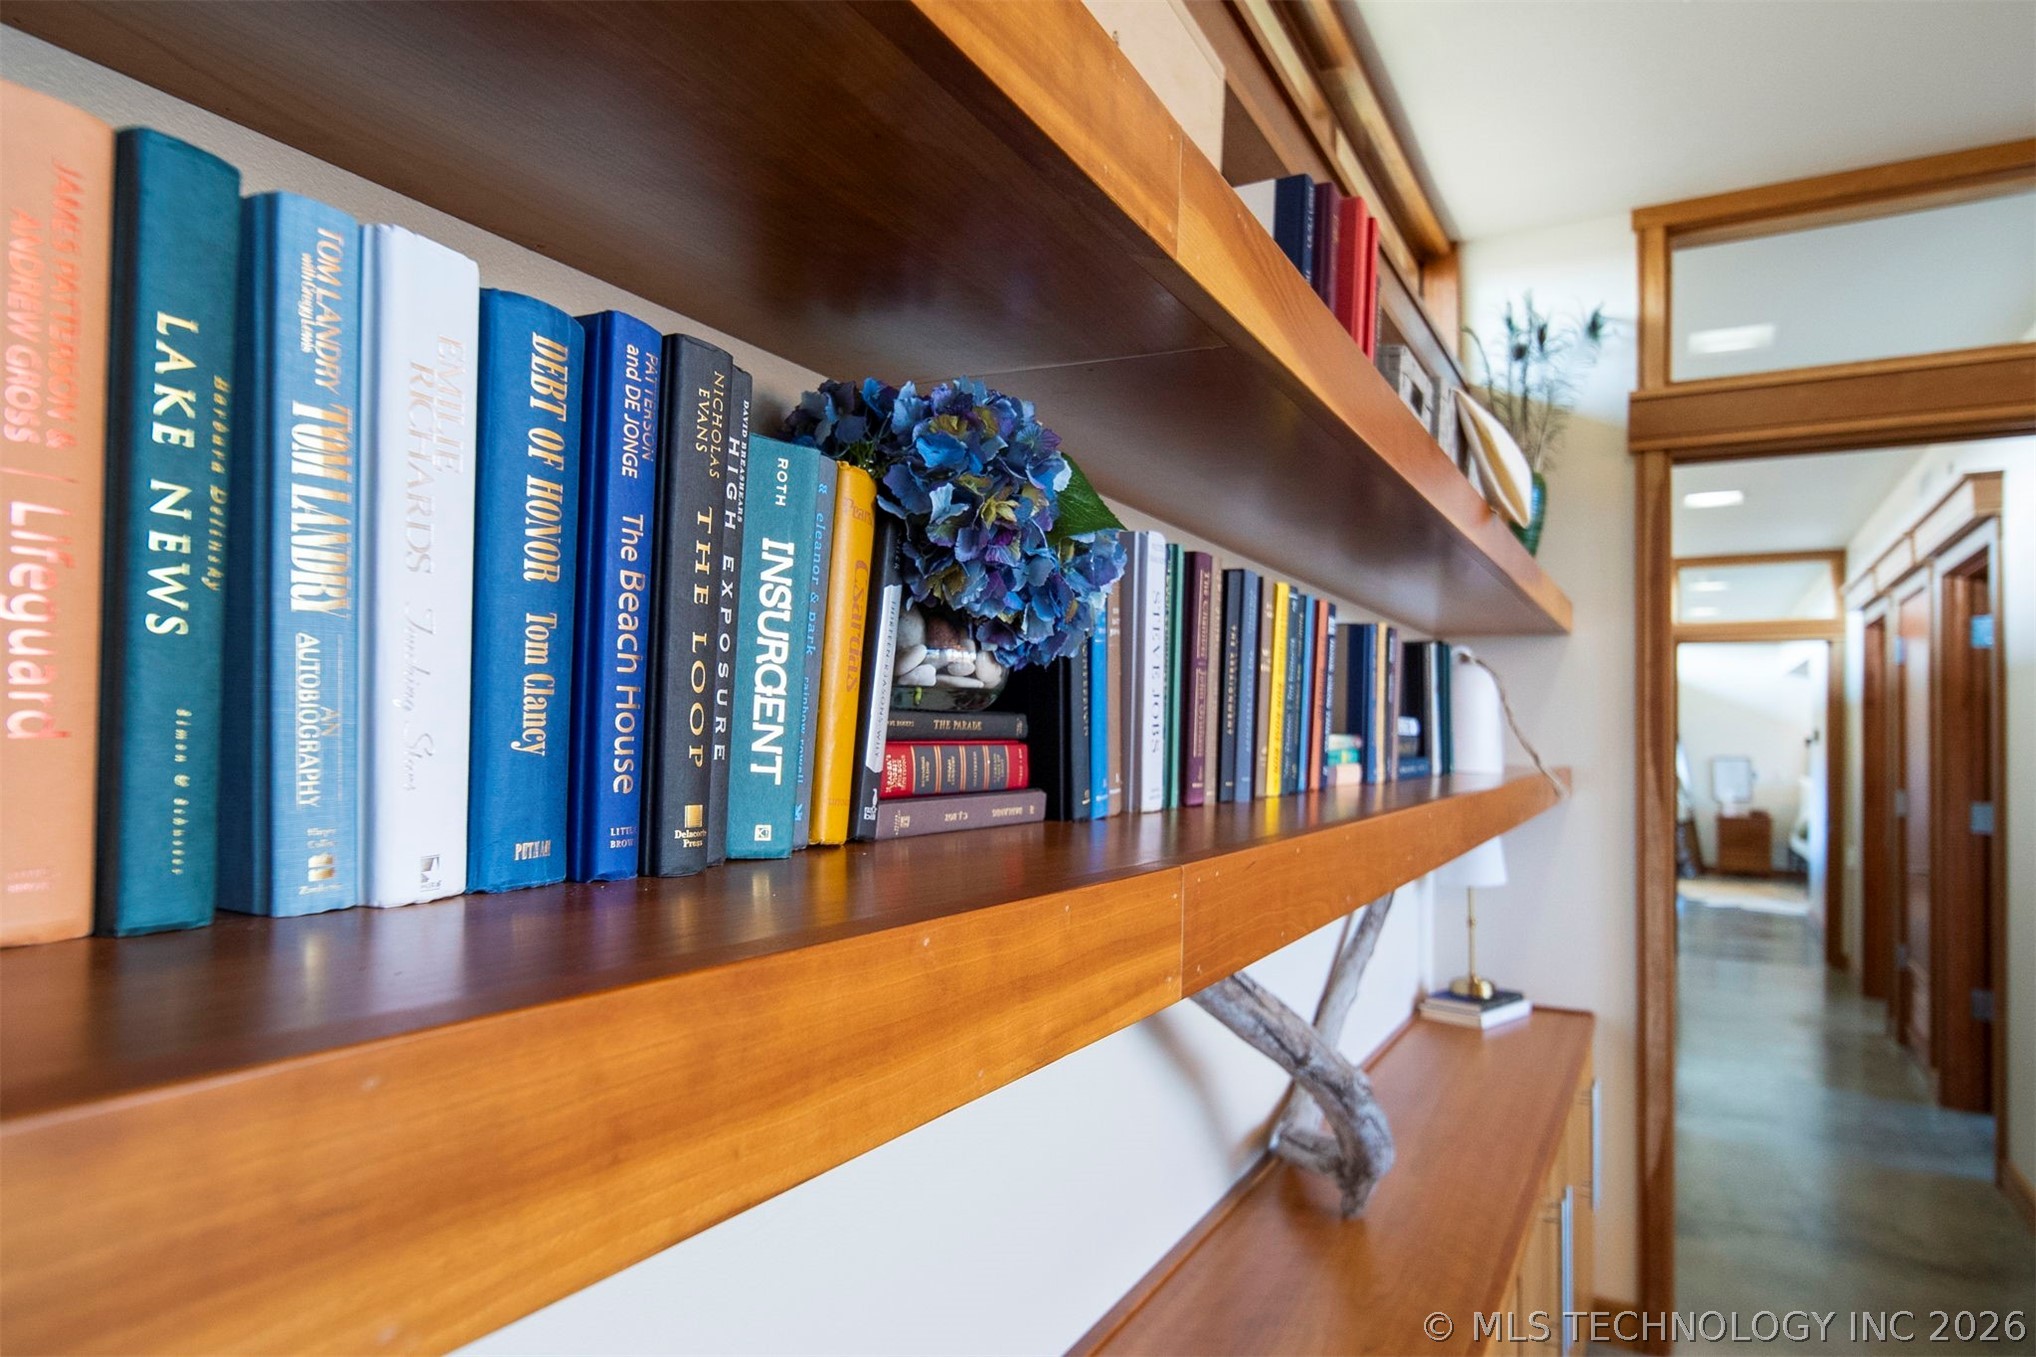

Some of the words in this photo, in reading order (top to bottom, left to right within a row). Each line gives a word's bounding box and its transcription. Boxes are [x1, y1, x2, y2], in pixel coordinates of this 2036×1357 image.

[51, 161, 84, 256] JAMES
[316, 227, 345, 287] TOM
[6, 207, 44, 343] ANDREW
[47, 258, 83, 424] PATTERSON
[151, 310, 199, 449] LAKE
[314, 287, 343, 396] LANDRY
[529, 330, 569, 423] DEBT
[625, 343, 642, 383] and
[3, 344, 43, 444] GROSS
[208, 374, 232, 474] Barbara
[291, 399, 353, 484] TOM
[433, 334, 467, 474] EMILIE
[624, 384, 642, 412] DE
[641, 351, 659, 463] PATTERSON
[695, 387, 710, 453] EVANS
[709, 370, 726, 479] NICHOLAS
[741, 399, 750, 438] DAVID
[404, 361, 438, 575] RICHARDS
[527, 427, 566, 472] OF
[621, 412, 641, 479] JONGE
[724, 436, 741, 530] HIGH
[737, 441, 748, 523] BREASHEARS
[774, 457, 789, 507] ROTH
[144, 478, 193, 635] NEWS
[201, 484, 229, 592] Delinsky
[290, 482, 352, 619] LANDRY
[522, 474, 564, 584] HONOR
[620, 514, 644, 562] The
[693, 506, 713, 605] THE
[811, 512, 828, 586] eleanor
[0, 501, 77, 739] Lifeguard
[524, 612, 558, 666] Tom
[616, 569, 646, 674] Beach
[805, 611, 818, 656] park
[808, 591, 820, 604] &
[846, 559, 870, 693] Csardas
[1151, 590, 1161, 680] STEVE
[687, 631, 708, 768] LOOP
[713, 554, 735, 761] EXPOSURE
[749, 537, 796, 786] INSURGENT
[297, 631, 323, 809] AUTOBIOGRAPHY
[319, 706, 341, 737] AN
[510, 673, 556, 757] Clancy
[612, 685, 642, 795] House
[933, 719, 951, 730] THE
[952, 720, 983, 731] PARADE
[1150, 688, 1161, 753] JOBS
